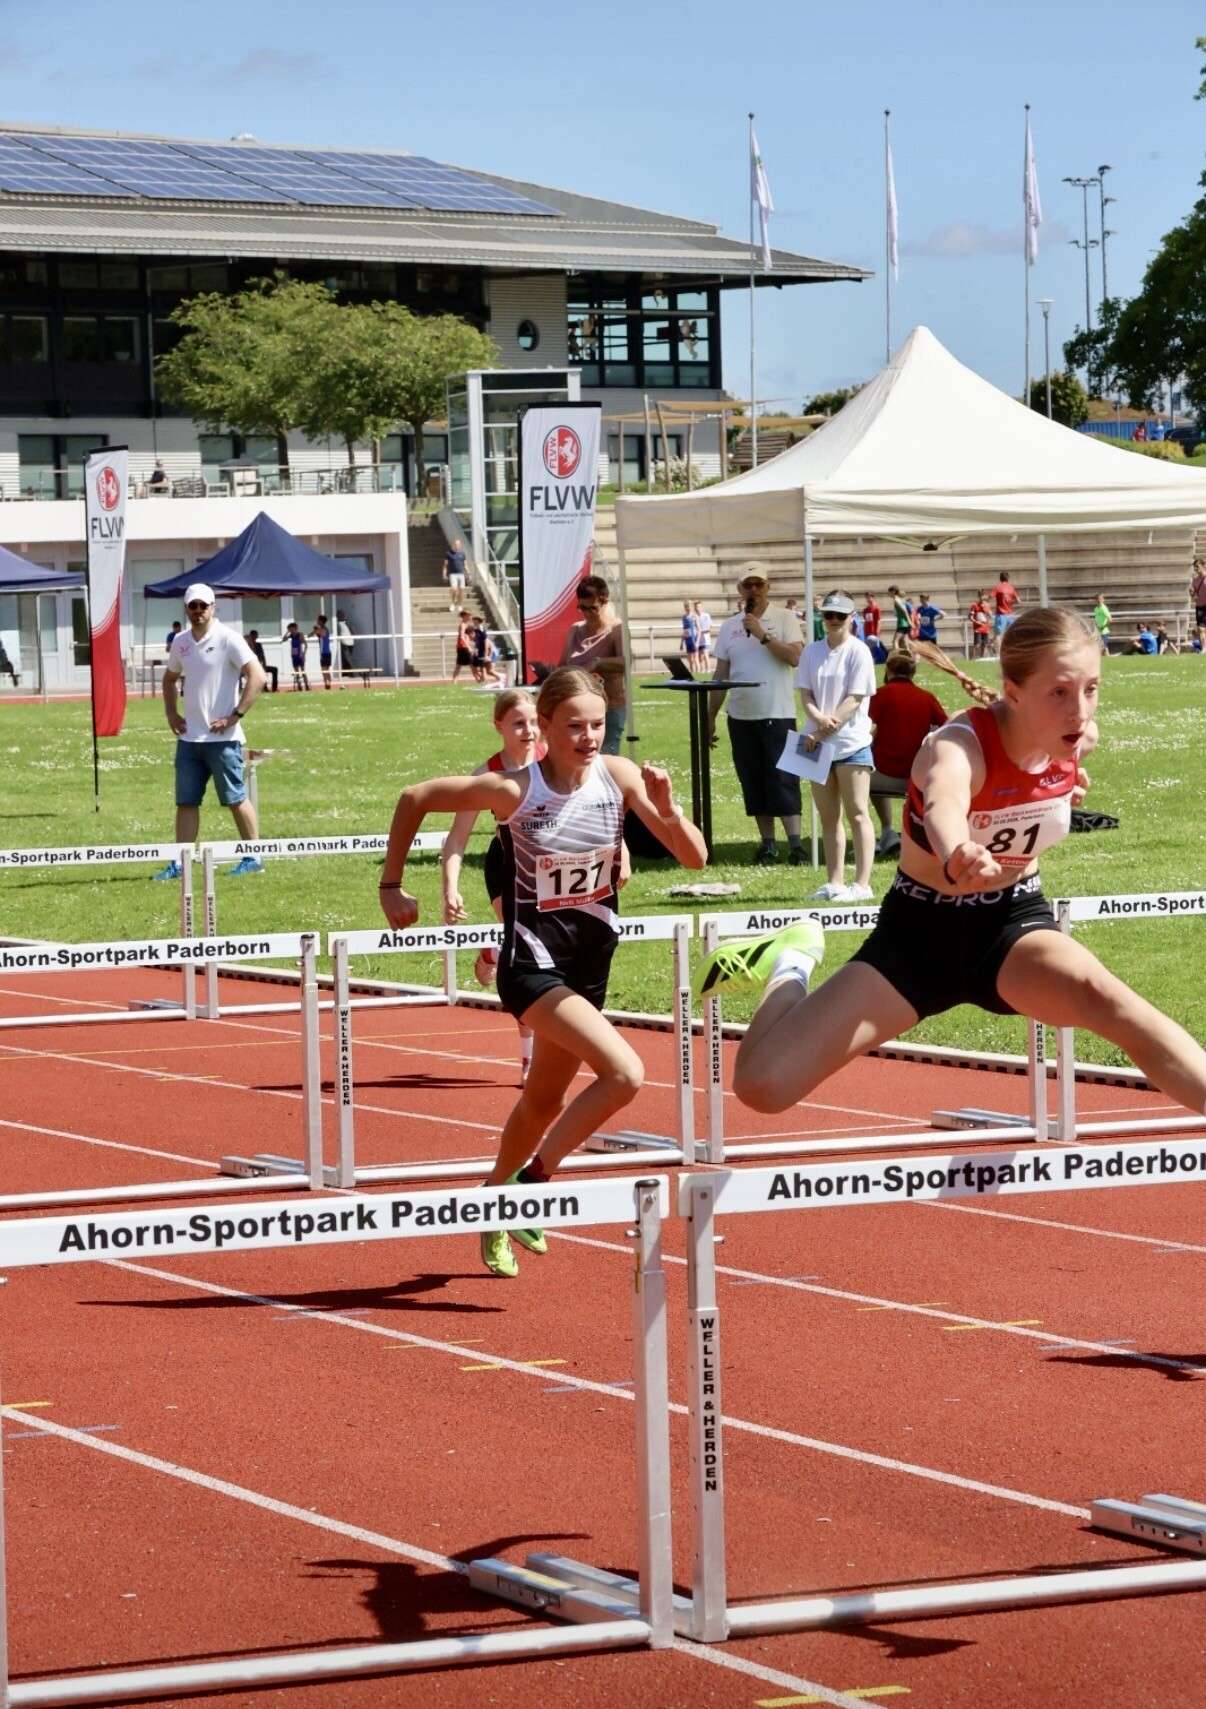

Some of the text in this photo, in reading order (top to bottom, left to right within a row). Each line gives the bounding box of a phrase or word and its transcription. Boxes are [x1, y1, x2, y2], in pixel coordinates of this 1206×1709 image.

[530, 485, 595, 510] FLVW
[87, 848, 159, 860] Paderborn
[986, 823, 1040, 854] 81
[548, 860, 604, 896] 127
[0, 941, 270, 967] horn-Sportpark Paderborn
[340, 1010, 348, 1052] WELLER
[681, 992, 689, 1032] WELLER
[712, 1042, 720, 1083] HERDEN
[1036, 1023, 1044, 1063] HERDEN
[342, 1063, 351, 1104] HERDEN
[768, 1155, 1051, 1200] Ahorn-Sportpark
[59, 1194, 579, 1253] Ahorn-Sportpark Paderborn
[701, 1318, 717, 1492] WELLER & HERDEN
